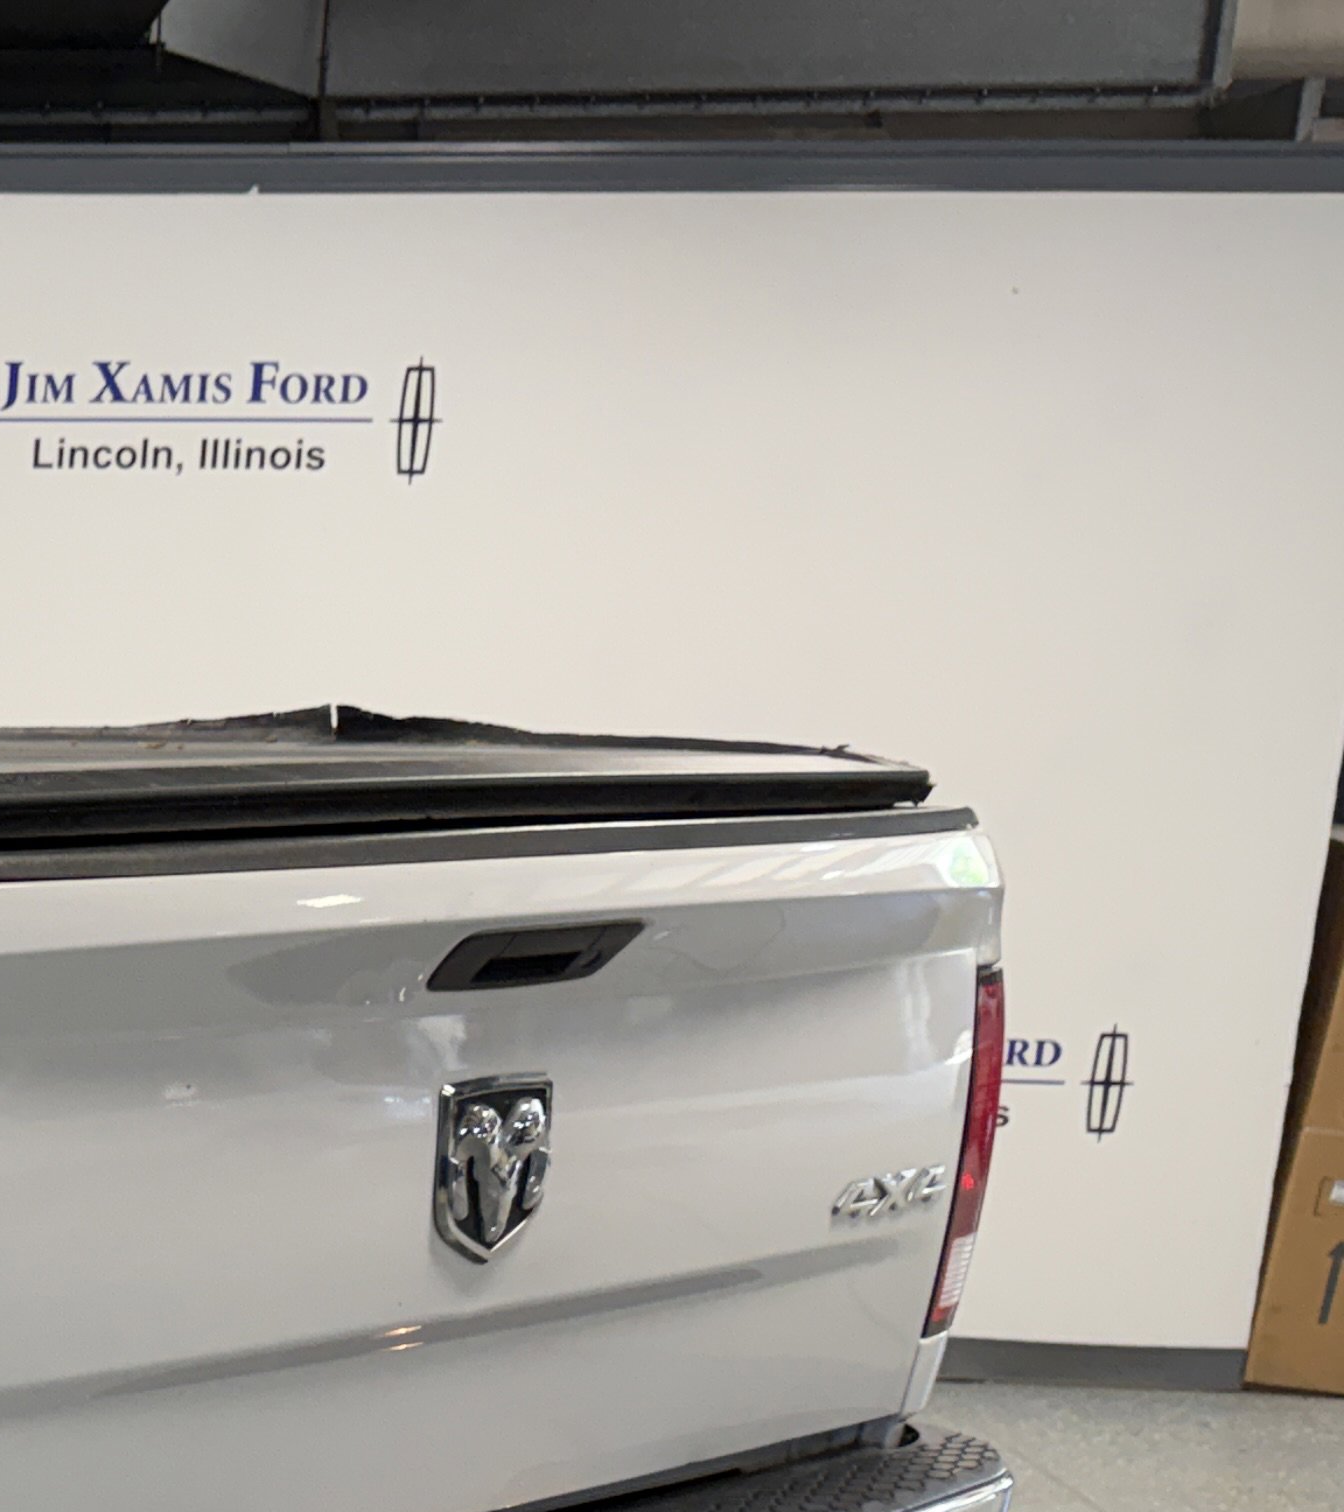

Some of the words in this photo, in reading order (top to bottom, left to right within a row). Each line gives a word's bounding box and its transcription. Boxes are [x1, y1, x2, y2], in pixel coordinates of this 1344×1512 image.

[32, 438, 185, 475] Lincoln,
[199, 437, 326, 471] Illinois
[1005, 1038, 1061, 1067] RD
